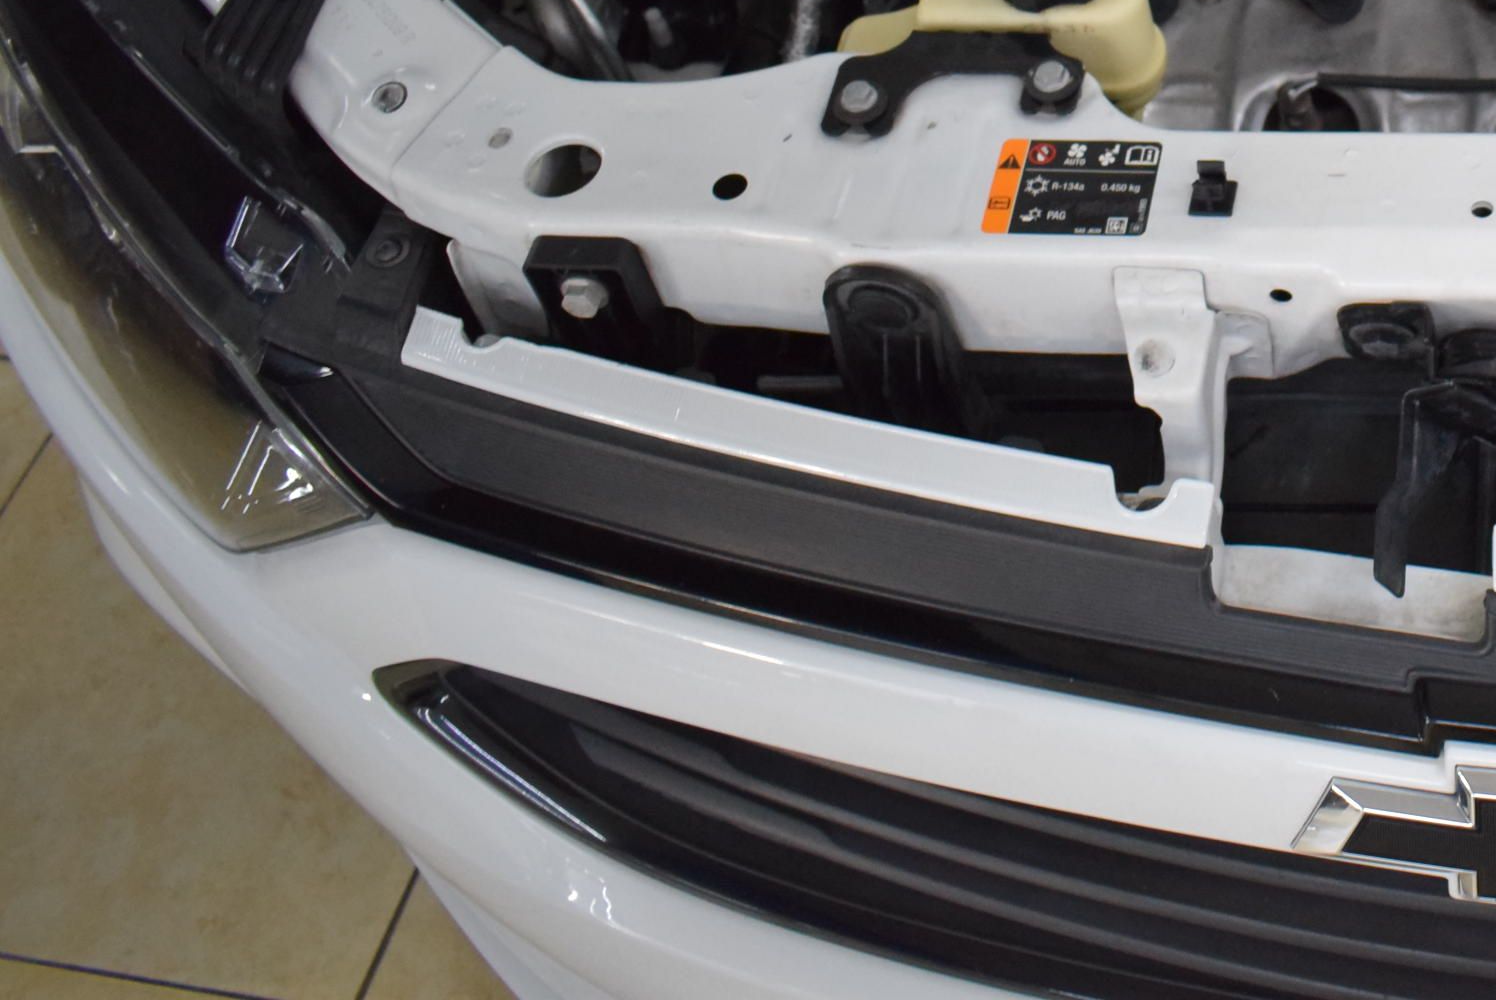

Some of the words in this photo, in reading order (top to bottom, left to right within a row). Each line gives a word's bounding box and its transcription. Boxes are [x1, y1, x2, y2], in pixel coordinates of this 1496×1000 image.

[1064, 157, 1086, 167] AUTO
[1051, 182, 1085, 193] R-134a
[1100, 183, 1126, 193] 0.450
[1128, 182, 1141, 195] kg
[1046, 209, 1067, 222] PAG
